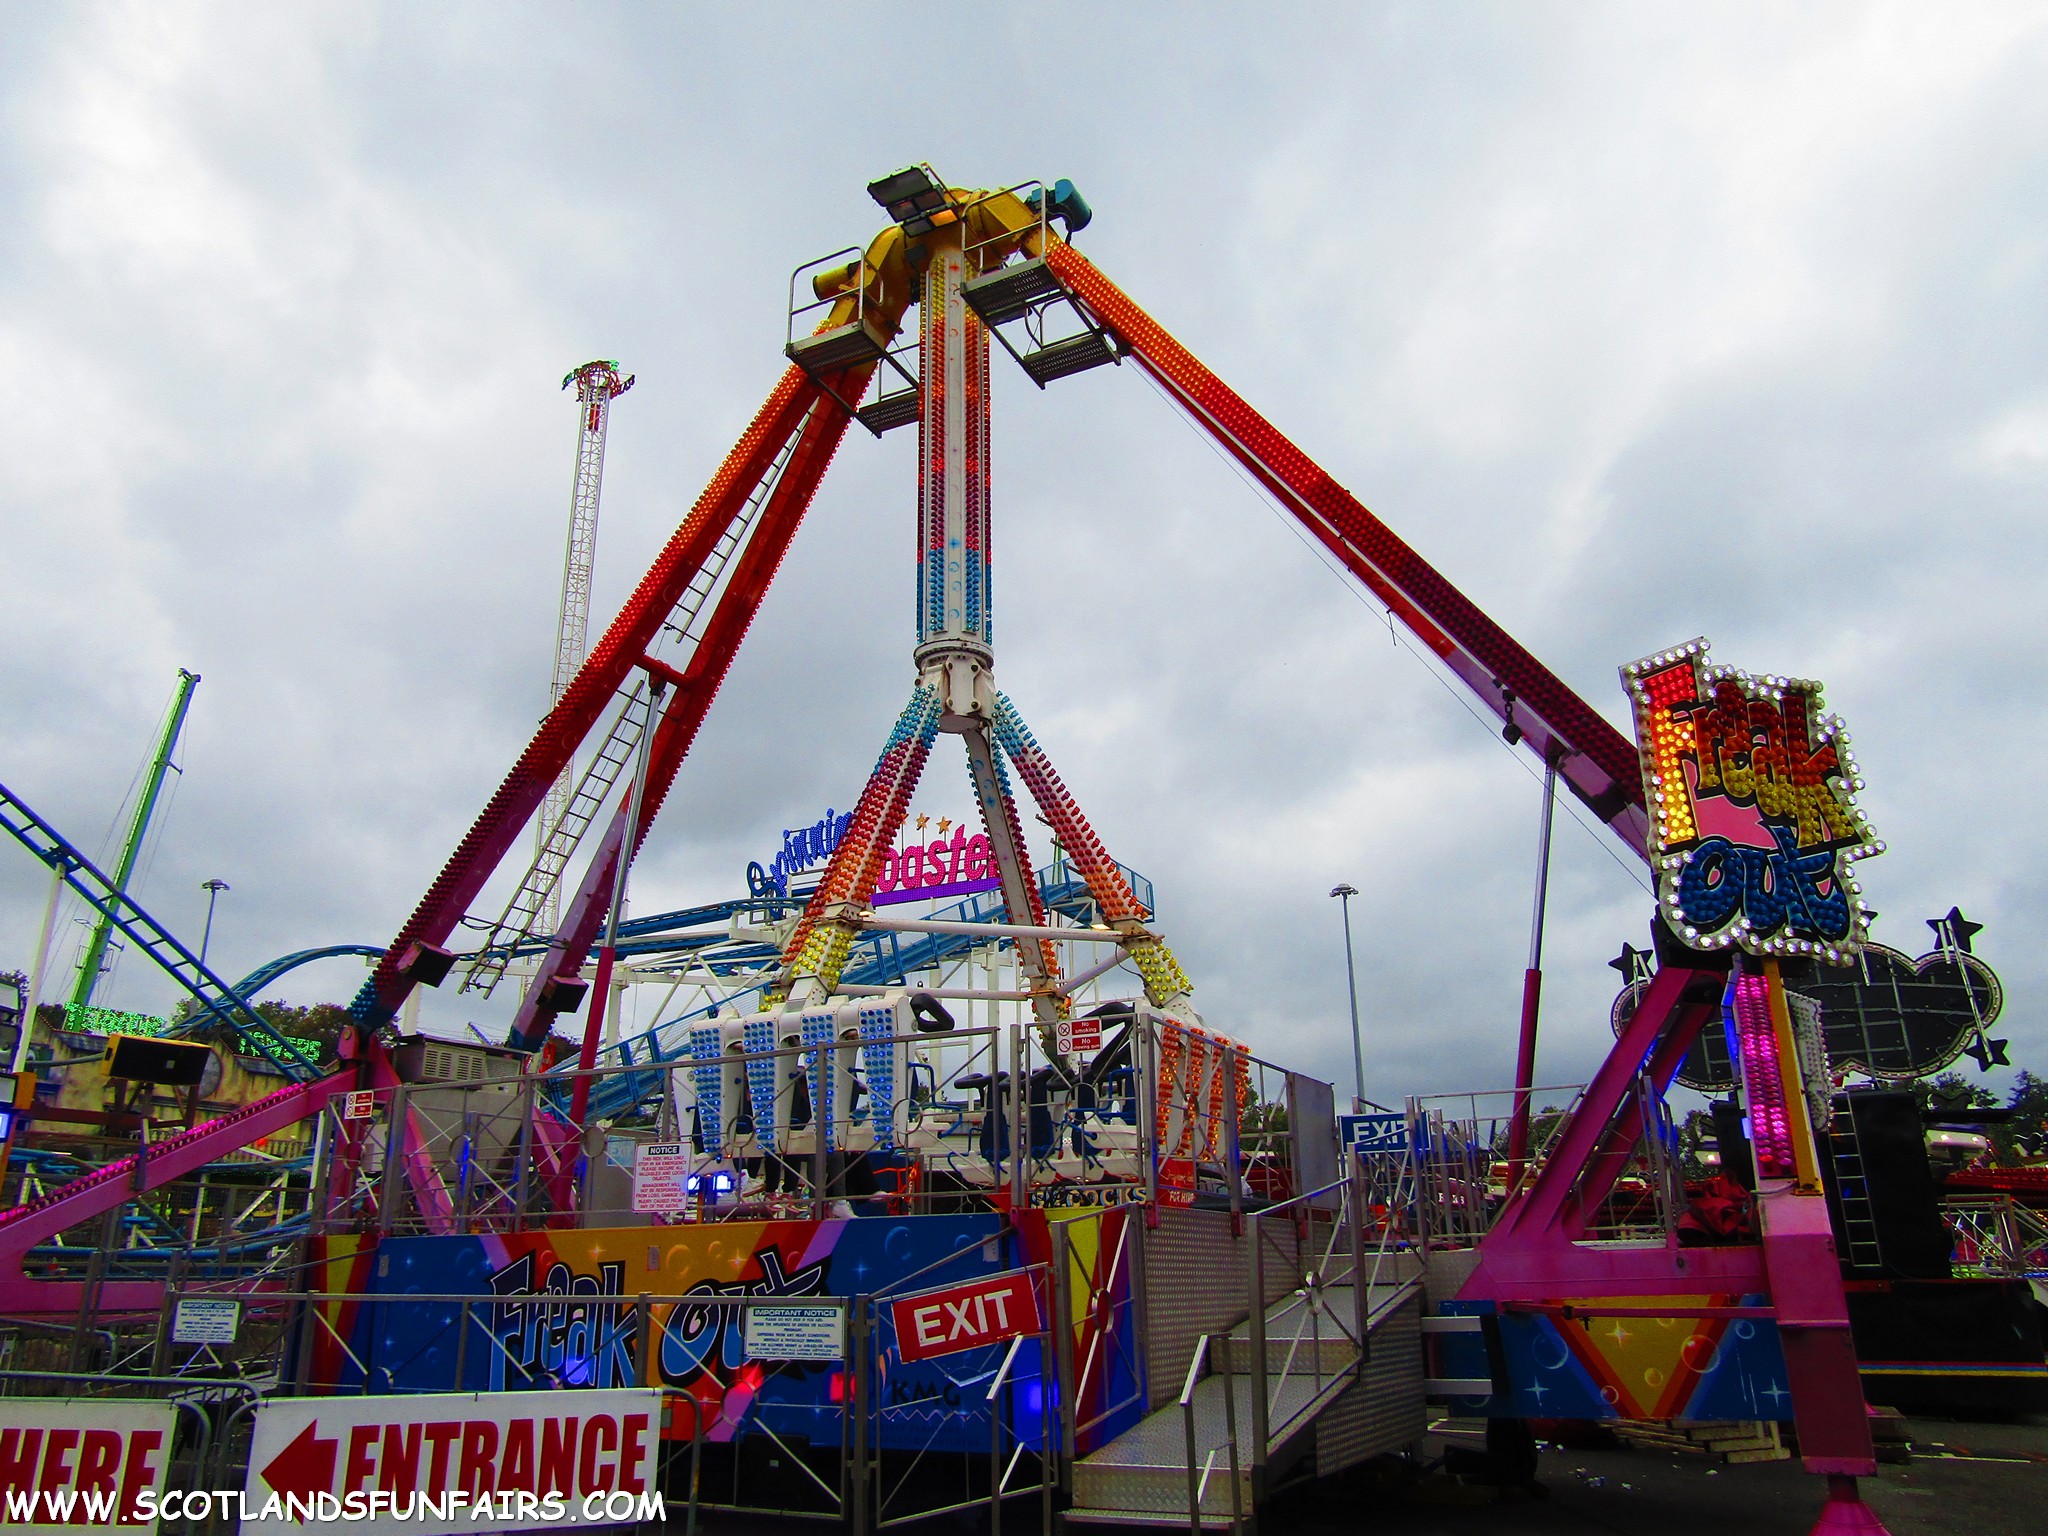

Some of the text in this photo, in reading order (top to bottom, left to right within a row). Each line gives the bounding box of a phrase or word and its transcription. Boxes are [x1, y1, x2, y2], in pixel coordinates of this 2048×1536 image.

[1641, 660, 1858, 848] Freak
[747, 808, 853, 918] Spinnin
[876, 824, 1000, 893] oaste
[1677, 826, 1851, 936] Out
[486, 1252, 640, 1392] Freak
[914, 1289, 1013, 1347] EXIT
[891, 1379, 960, 1408] KMG
[0, 1427, 163, 1527] HERE
[344, 1413, 650, 1510] ENTRANCE
